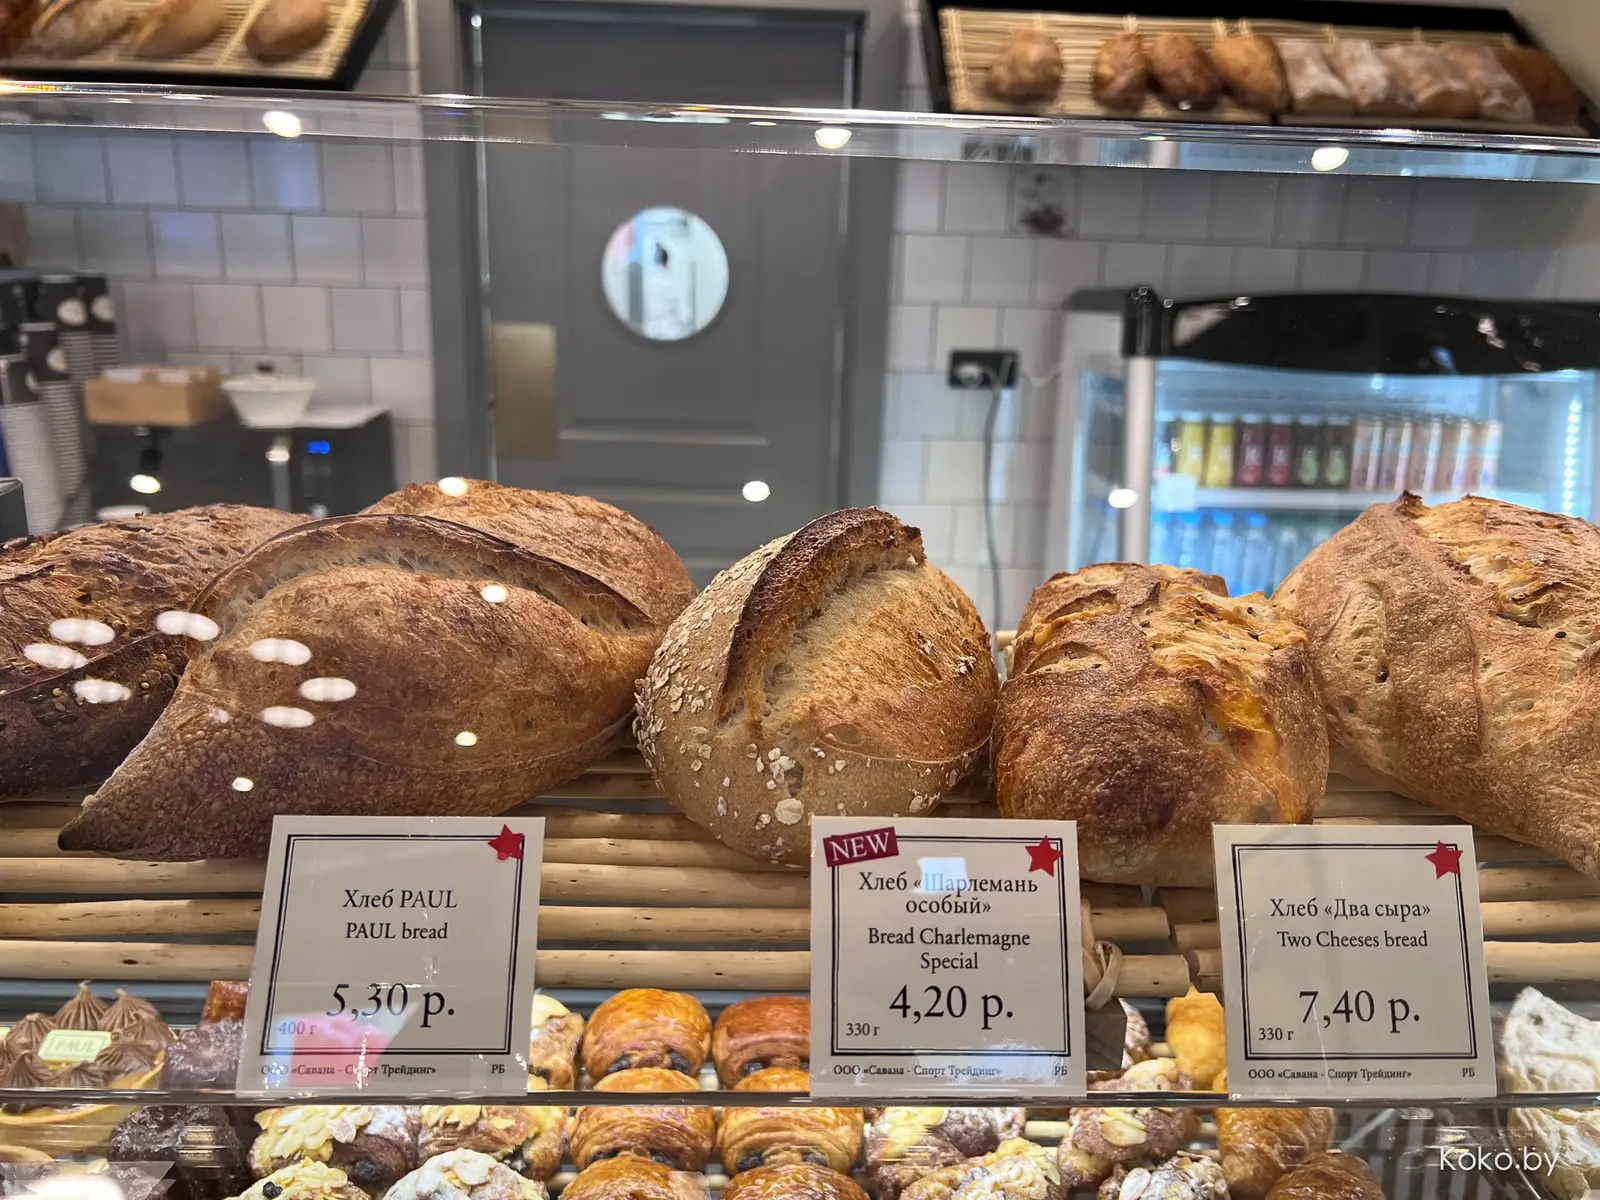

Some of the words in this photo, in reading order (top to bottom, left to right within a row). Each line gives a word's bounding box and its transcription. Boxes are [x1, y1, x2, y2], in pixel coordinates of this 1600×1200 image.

[828, 831, 891, 862] NEW
[858, 871, 907, 890] Хлеб
[913, 872, 1038, 897] «Шарлемань
[342, 888, 394, 908] Хлеб
[399, 889, 458, 908] PAUL
[906, 893, 992, 914] особый»
[1270, 897, 1318, 917] Хлеб
[1324, 898, 1370, 921] «Два
[1374, 903, 1431, 923] сыра»
[345, 922, 395, 939] PAUL
[402, 922, 449, 940] bread
[868, 928, 914, 945] Bread
[920, 928, 1031, 949] Charlemagne
[1276, 931, 1311, 947] Two
[1316, 930, 1380, 947] Cheeses
[1384, 930, 1429, 947] bread
[920, 952, 979, 974] Special
[326, 983, 409, 1021] 5,30
[420, 991, 455, 1028] р.
[889, 985, 968, 1024] 4,20
[981, 992, 1014, 1030] р.
[1299, 989, 1375, 1028] 7,40
[1388, 997, 1420, 1033] р.
[279, 1021, 305, 1035] 400
[309, 1024, 317, 1035] г
[846, 1023, 870, 1036] 330
[872, 1025, 880, 1036] г
[1258, 1027, 1283, 1041] 330
[1286, 1030, 1294, 1041] г
[291, 1064, 335, 1075] «Савана
[381, 1064, 436, 1077] Трейдинг»
[491, 1064, 505, 1074] РБ
[833, 1065, 861, 1075] ООО
[863, 1065, 905, 1075] «Савана
[913, 1065, 947, 1078] Спорт
[948, 1065, 1001, 1078] Трейдинг»
[1054, 1065, 1068, 1076] РБ
[1248, 1069, 1275, 1079] ООО
[1278, 1069, 1318, 1079] «Савана
[1327, 1068, 1358, 1081] Спорт
[1360, 1068, 1412, 1081] Трейдинг»
[1462, 1067, 1475, 1077] РБ
